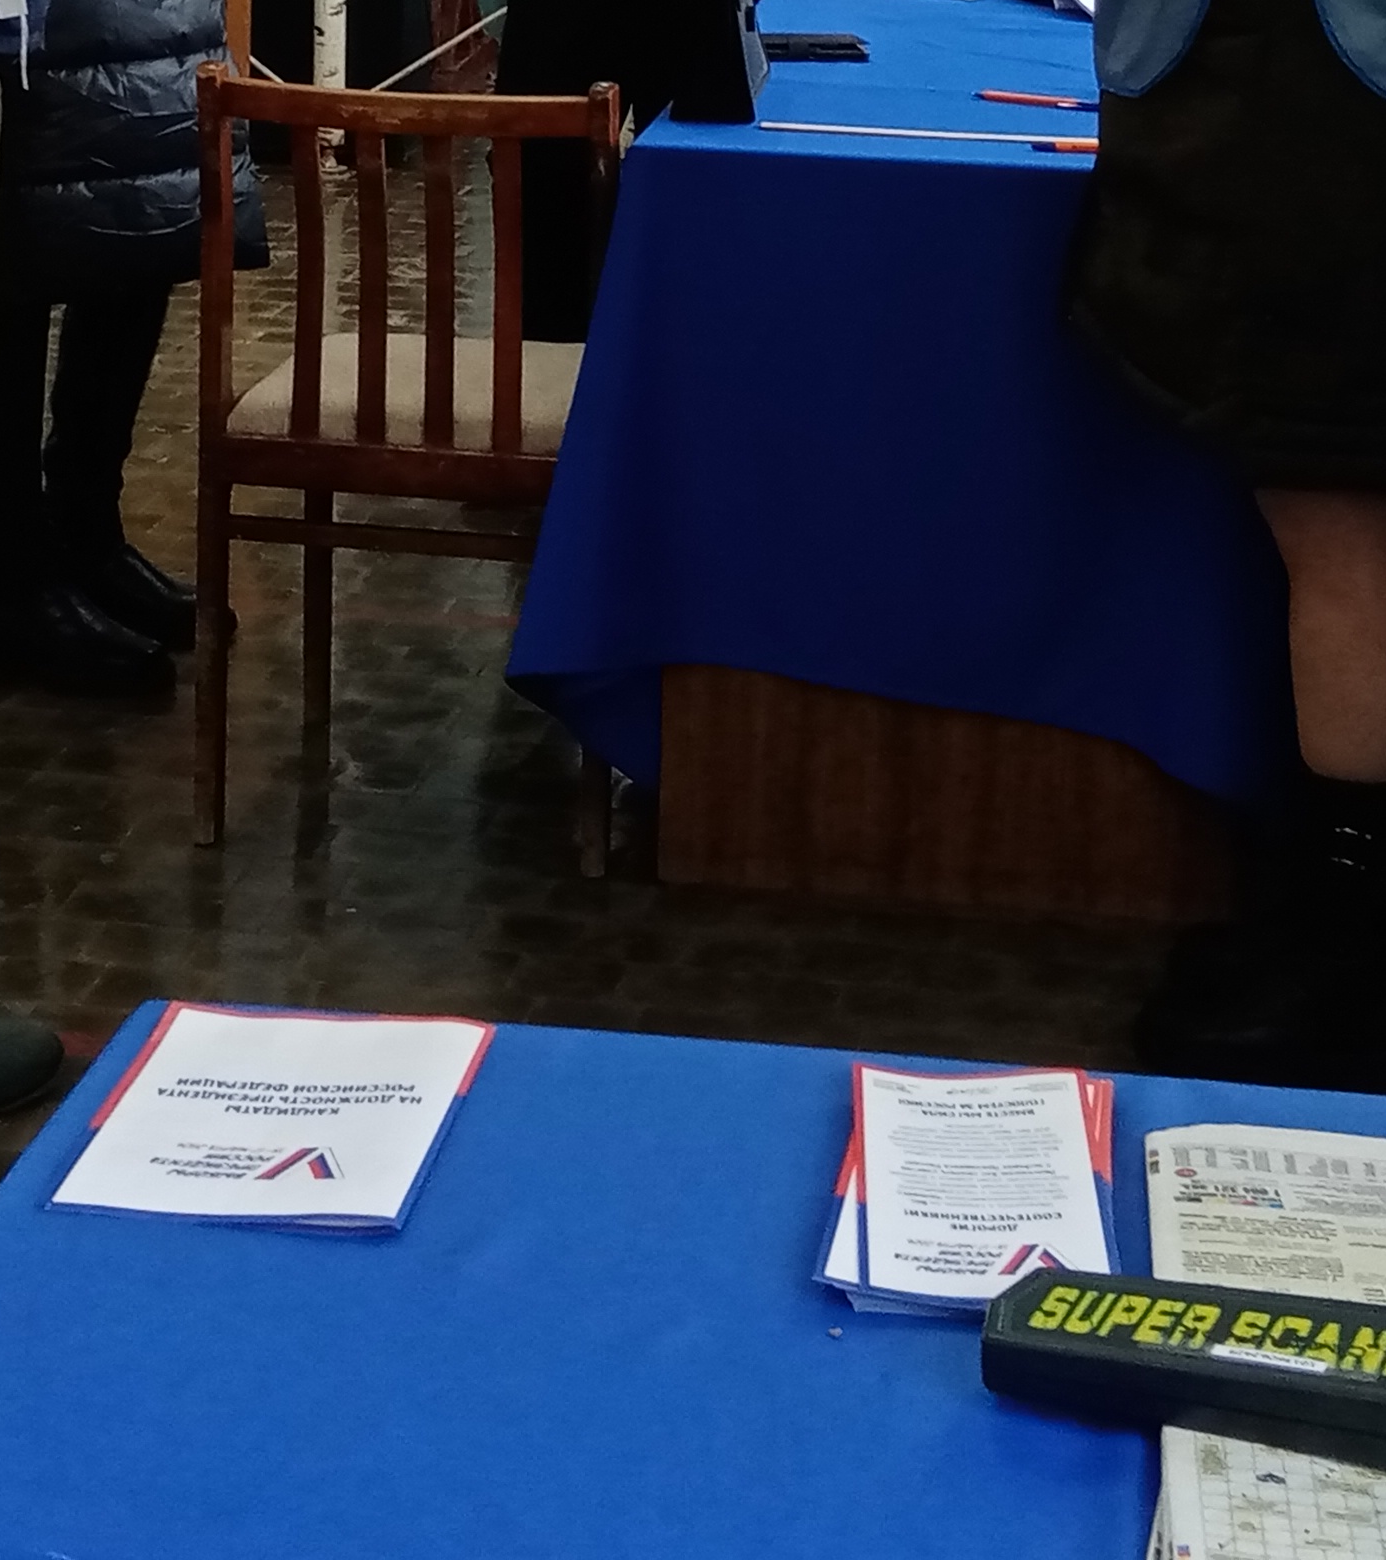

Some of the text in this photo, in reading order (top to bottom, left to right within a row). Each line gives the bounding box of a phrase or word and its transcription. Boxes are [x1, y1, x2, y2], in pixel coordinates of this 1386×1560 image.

[176, 1078, 415, 1094] РОССИЙСКОЙ ФЕДЕРАЦИИ
[157, 1087, 422, 1104] НА ДОЛЖНОСТЬ ПРЕЗИДЕНТА
[224, 1104, 340, 1115] КАНДИДАТЫ
[1027, 1284, 1222, 1349] SUPER
